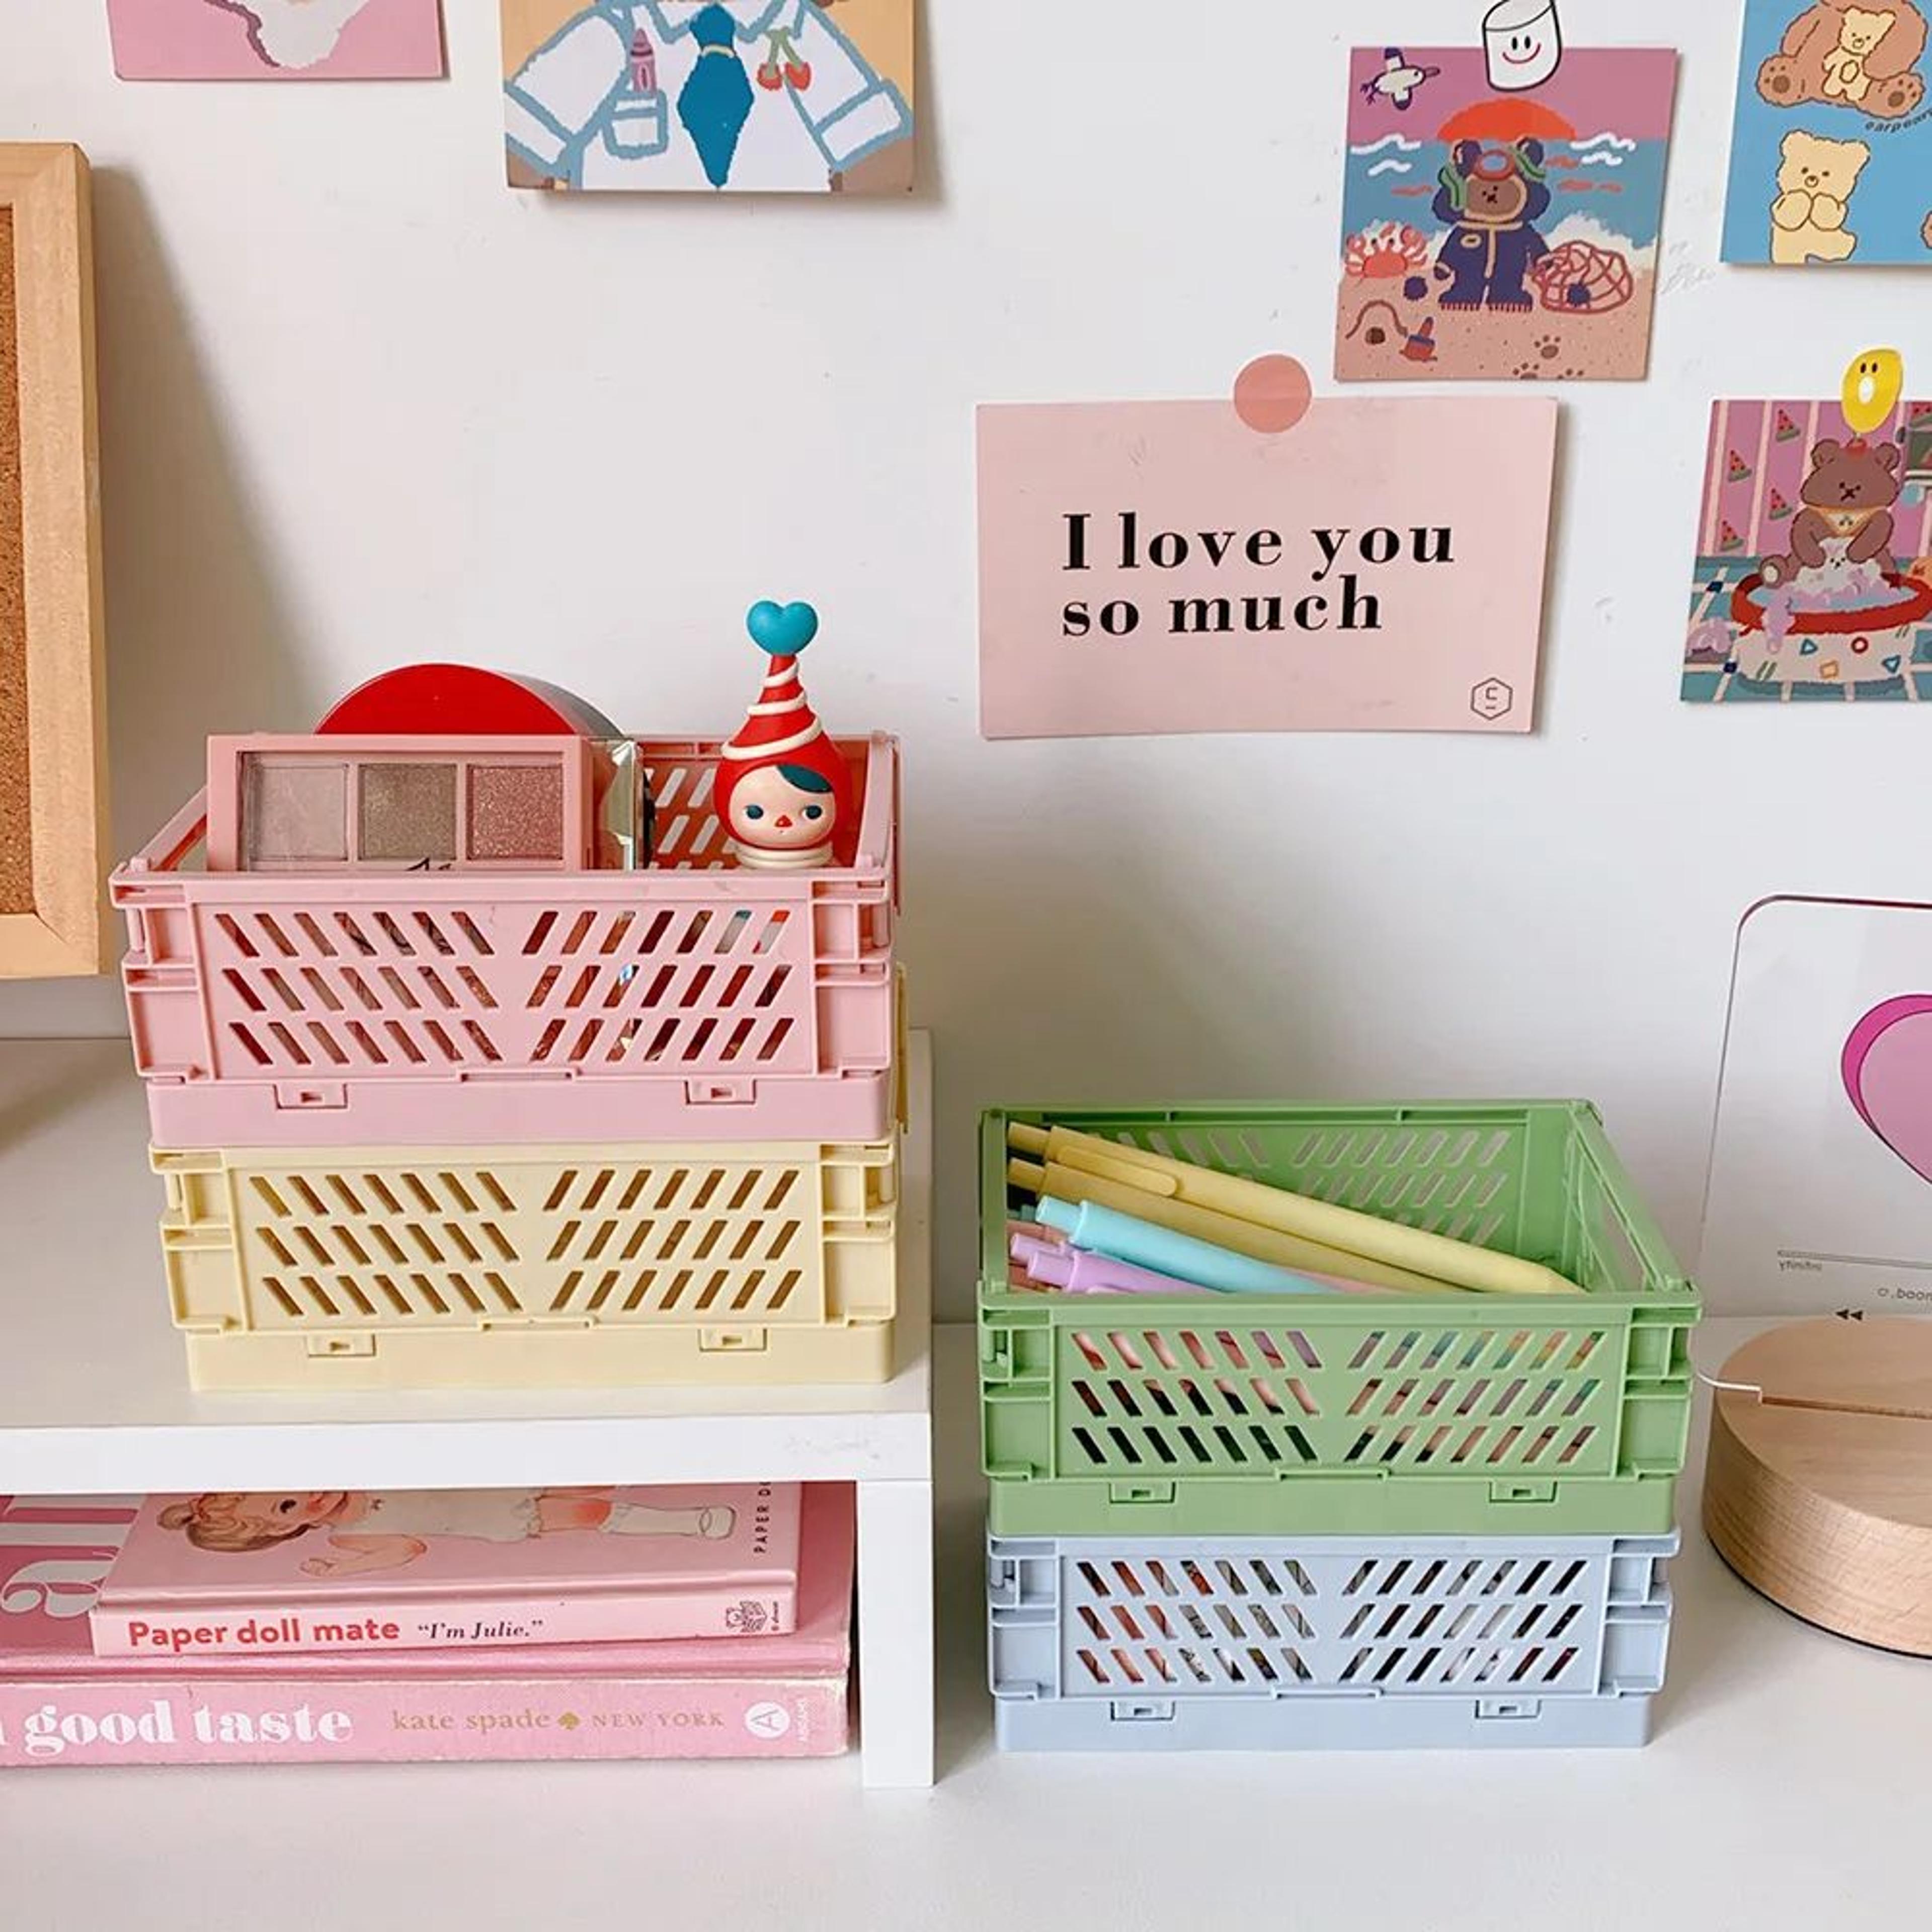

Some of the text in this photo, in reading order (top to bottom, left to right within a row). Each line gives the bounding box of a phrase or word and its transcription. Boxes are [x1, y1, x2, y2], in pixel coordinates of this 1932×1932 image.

[1063, 512, 1454, 582] I love you
[1063, 574, 1382, 636] so much
[753, 1505, 770, 1554] PAPER
[128, 1618, 400, 1652] Paper doll mate
[24, 1701, 174, 1756] good
[194, 1704, 351, 1743] taste
[392, 1708, 725, 1736] kate spade NEW YORK
